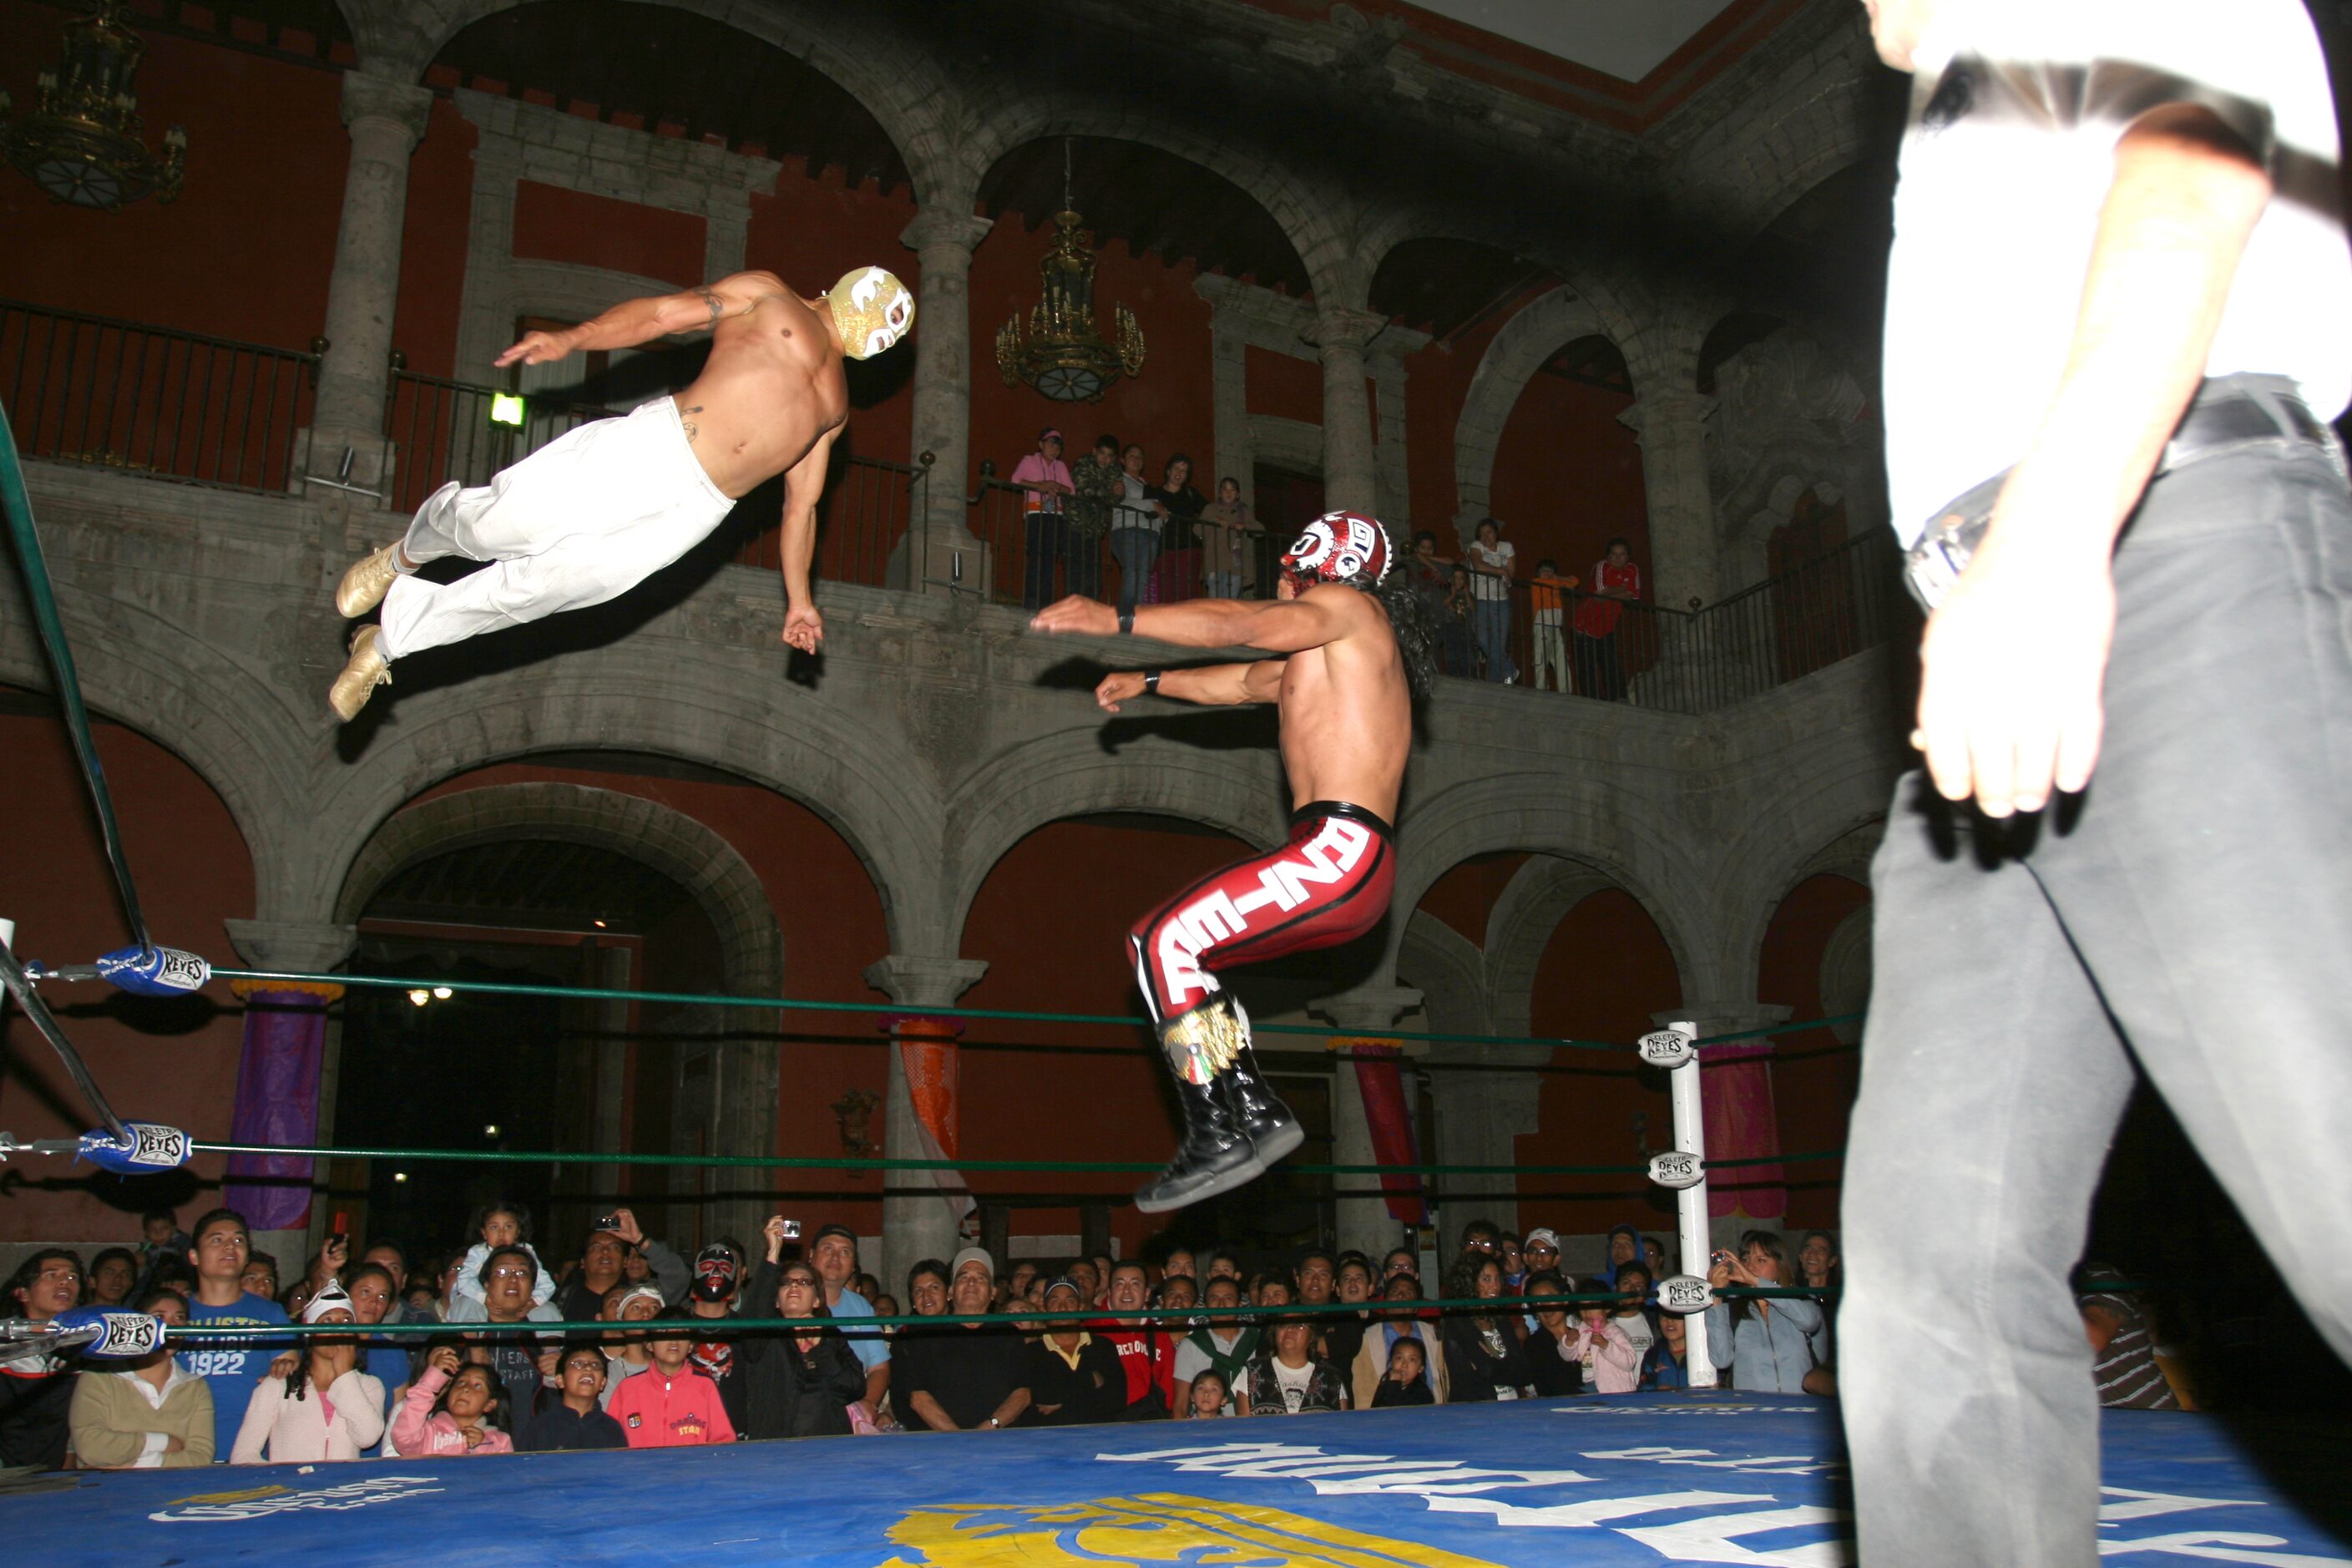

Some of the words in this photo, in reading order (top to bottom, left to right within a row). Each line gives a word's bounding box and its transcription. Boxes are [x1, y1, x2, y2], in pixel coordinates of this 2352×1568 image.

[162, 952, 201, 980] REYES
[1647, 1038, 1682, 1058] REYES
[136, 1130, 181, 1157] REYES
[1658, 1161, 1692, 1179] REYES
[1669, 1286, 1704, 1306] REYES
[104, 1321, 154, 1348] REYES
[189, 1353, 245, 1376] 1922
[679, 1425, 700, 1435] STAR
